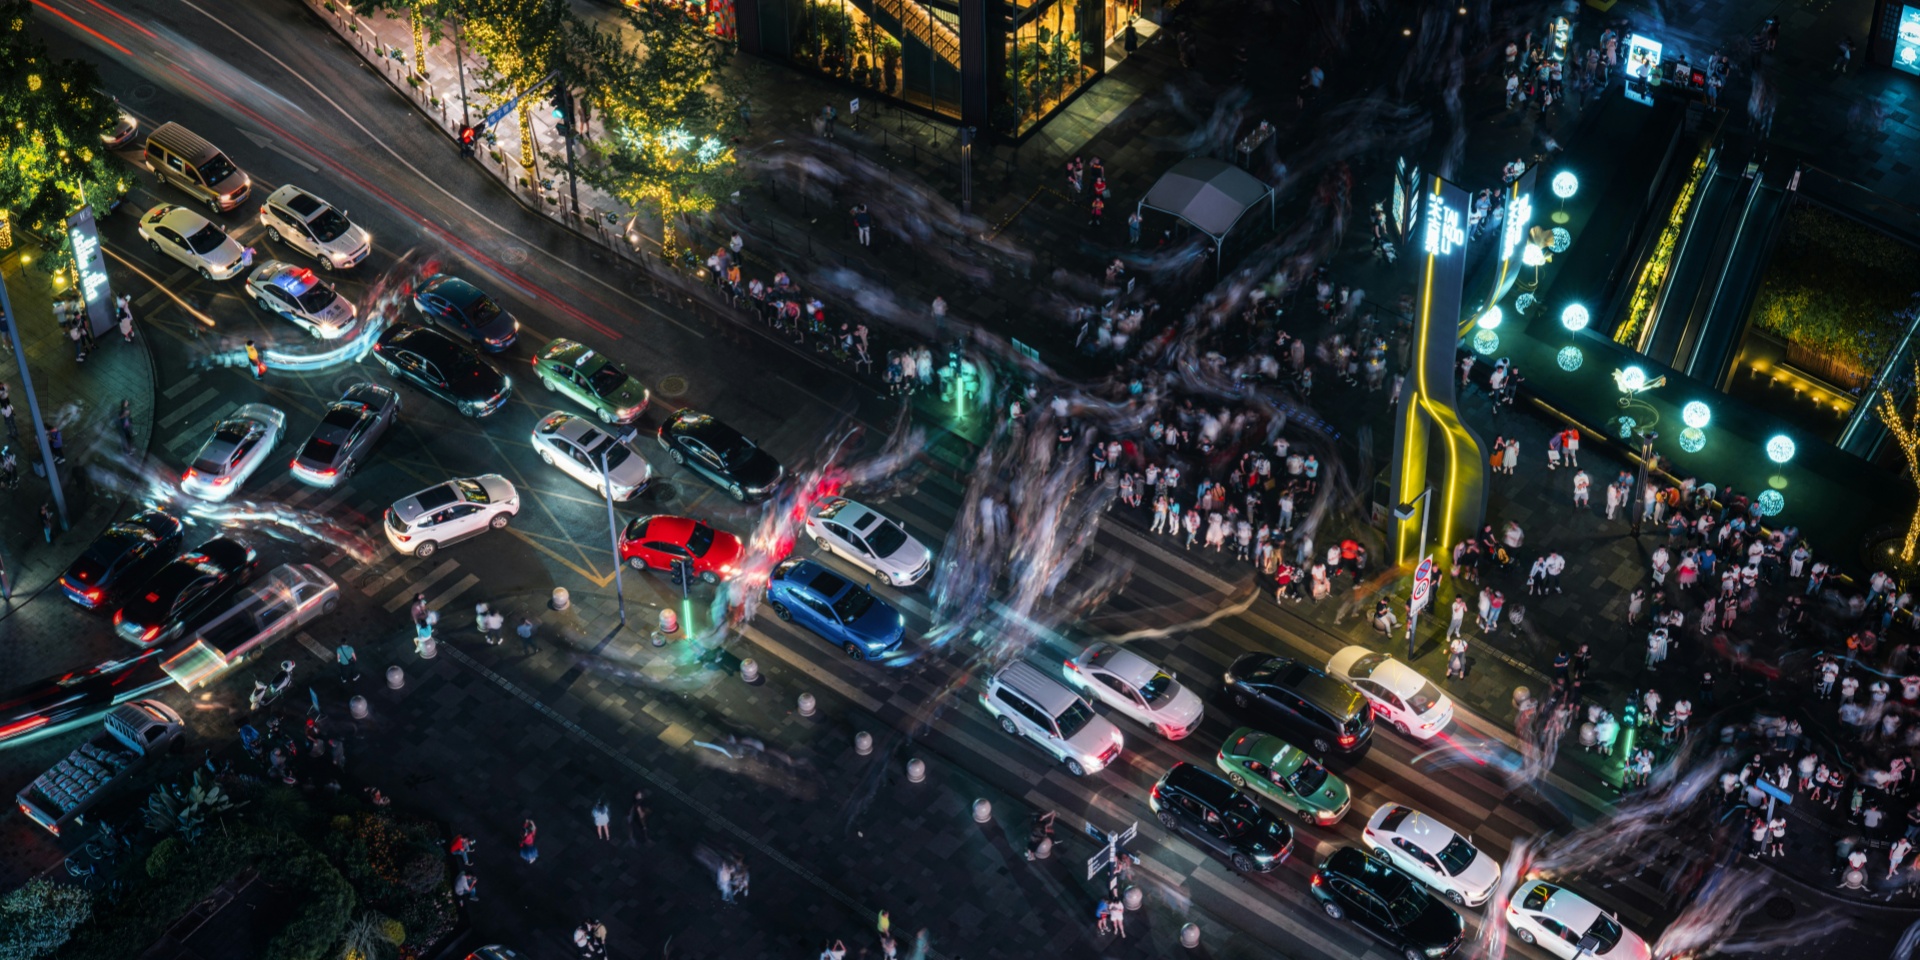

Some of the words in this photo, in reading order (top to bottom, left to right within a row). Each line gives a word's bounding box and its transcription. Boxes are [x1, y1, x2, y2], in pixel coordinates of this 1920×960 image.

[1443, 205, 1459, 228] TAI
[1442, 222, 1464, 246] KOO
[1416, 583, 1426, 595] 40
